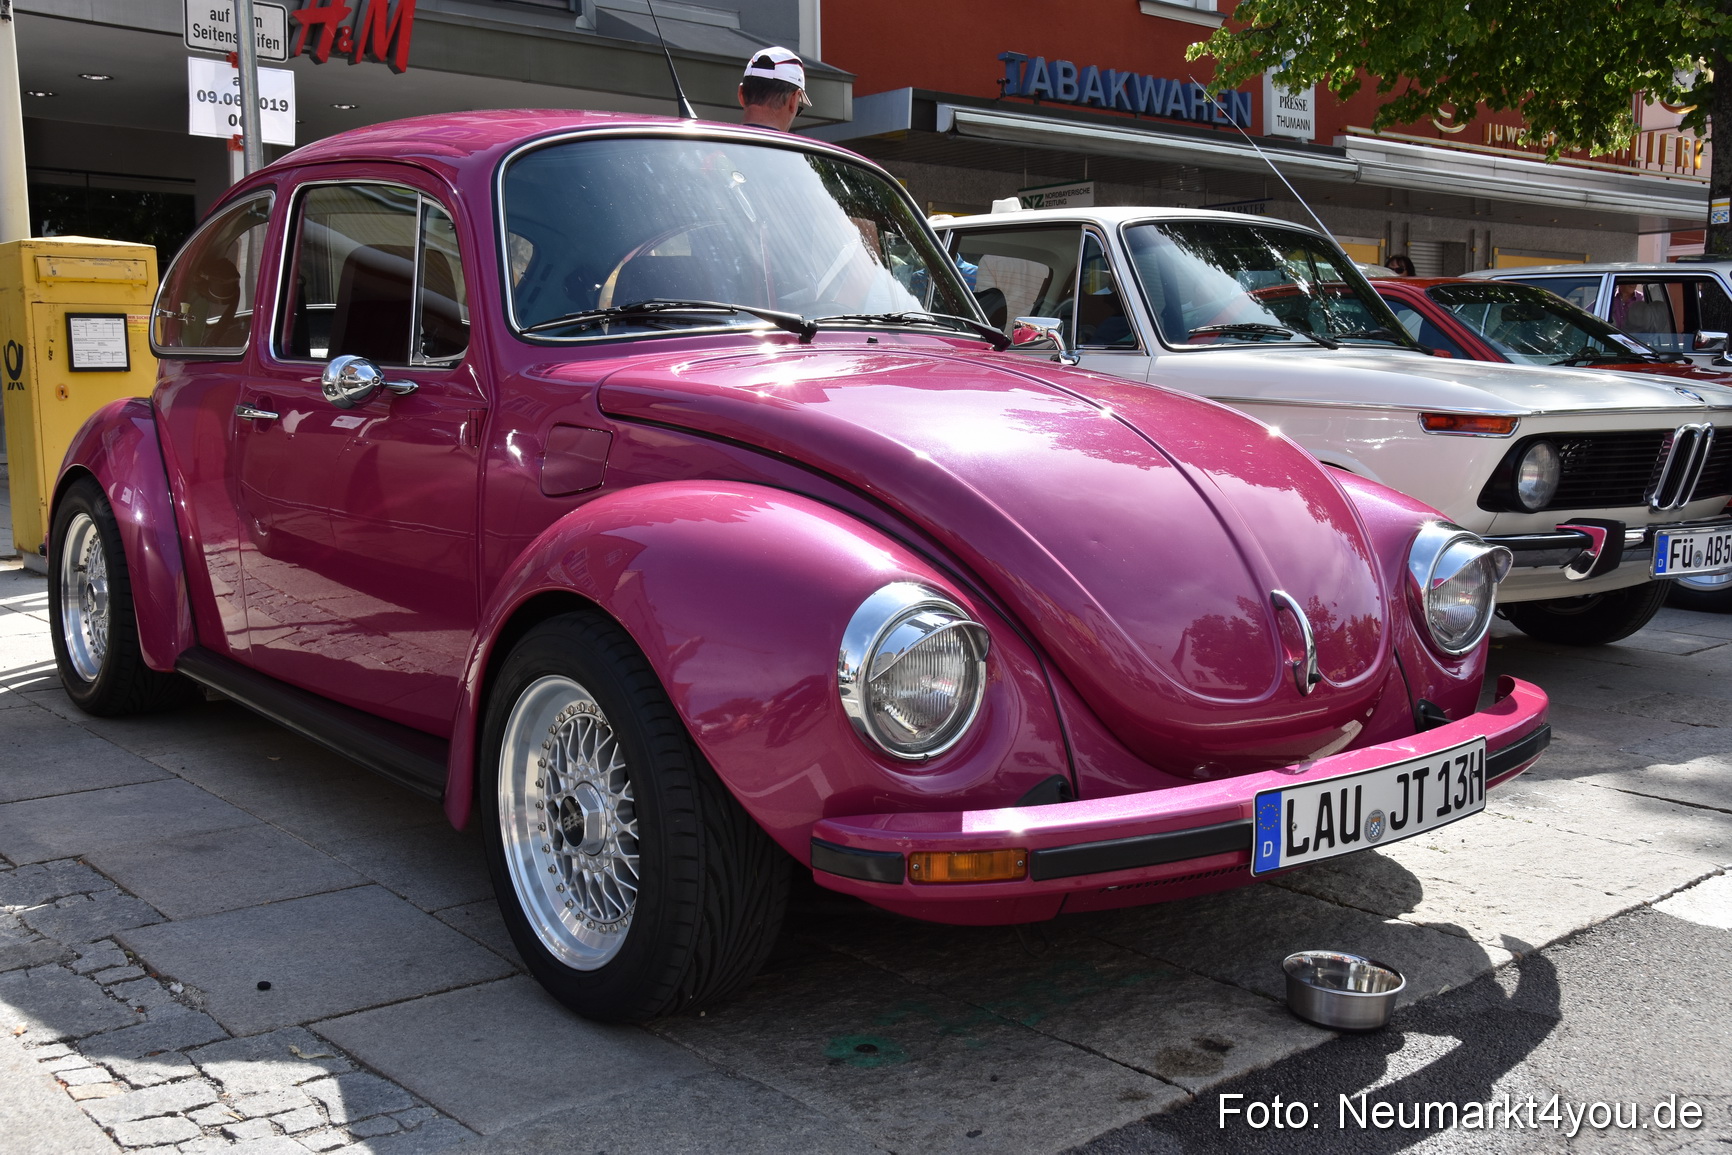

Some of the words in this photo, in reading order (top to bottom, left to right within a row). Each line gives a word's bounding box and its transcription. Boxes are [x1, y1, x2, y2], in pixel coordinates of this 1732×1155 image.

[209, 8, 230, 23] auf
[193, 23, 280, 50] Seitensifen
[998, 50, 1252, 128] TABAKWAREN
[197, 89, 289, 112] 09.06019
[1279, 95, 1308, 112] PRESSE
[1276, 114, 1311, 131] THUMANN
[1021, 193, 1045, 209] NZ
[1045, 187, 1091, 199] NORDBAYERISCHE
[1045, 198, 1067, 208] ZEITUNG
[1658, 559, 1664, 568] D
[1286, 785, 1362, 857] LAU
[1390, 766, 1430, 830] JT
[1436, 748, 1484, 817] 13H
[1262, 840, 1273, 858] D
